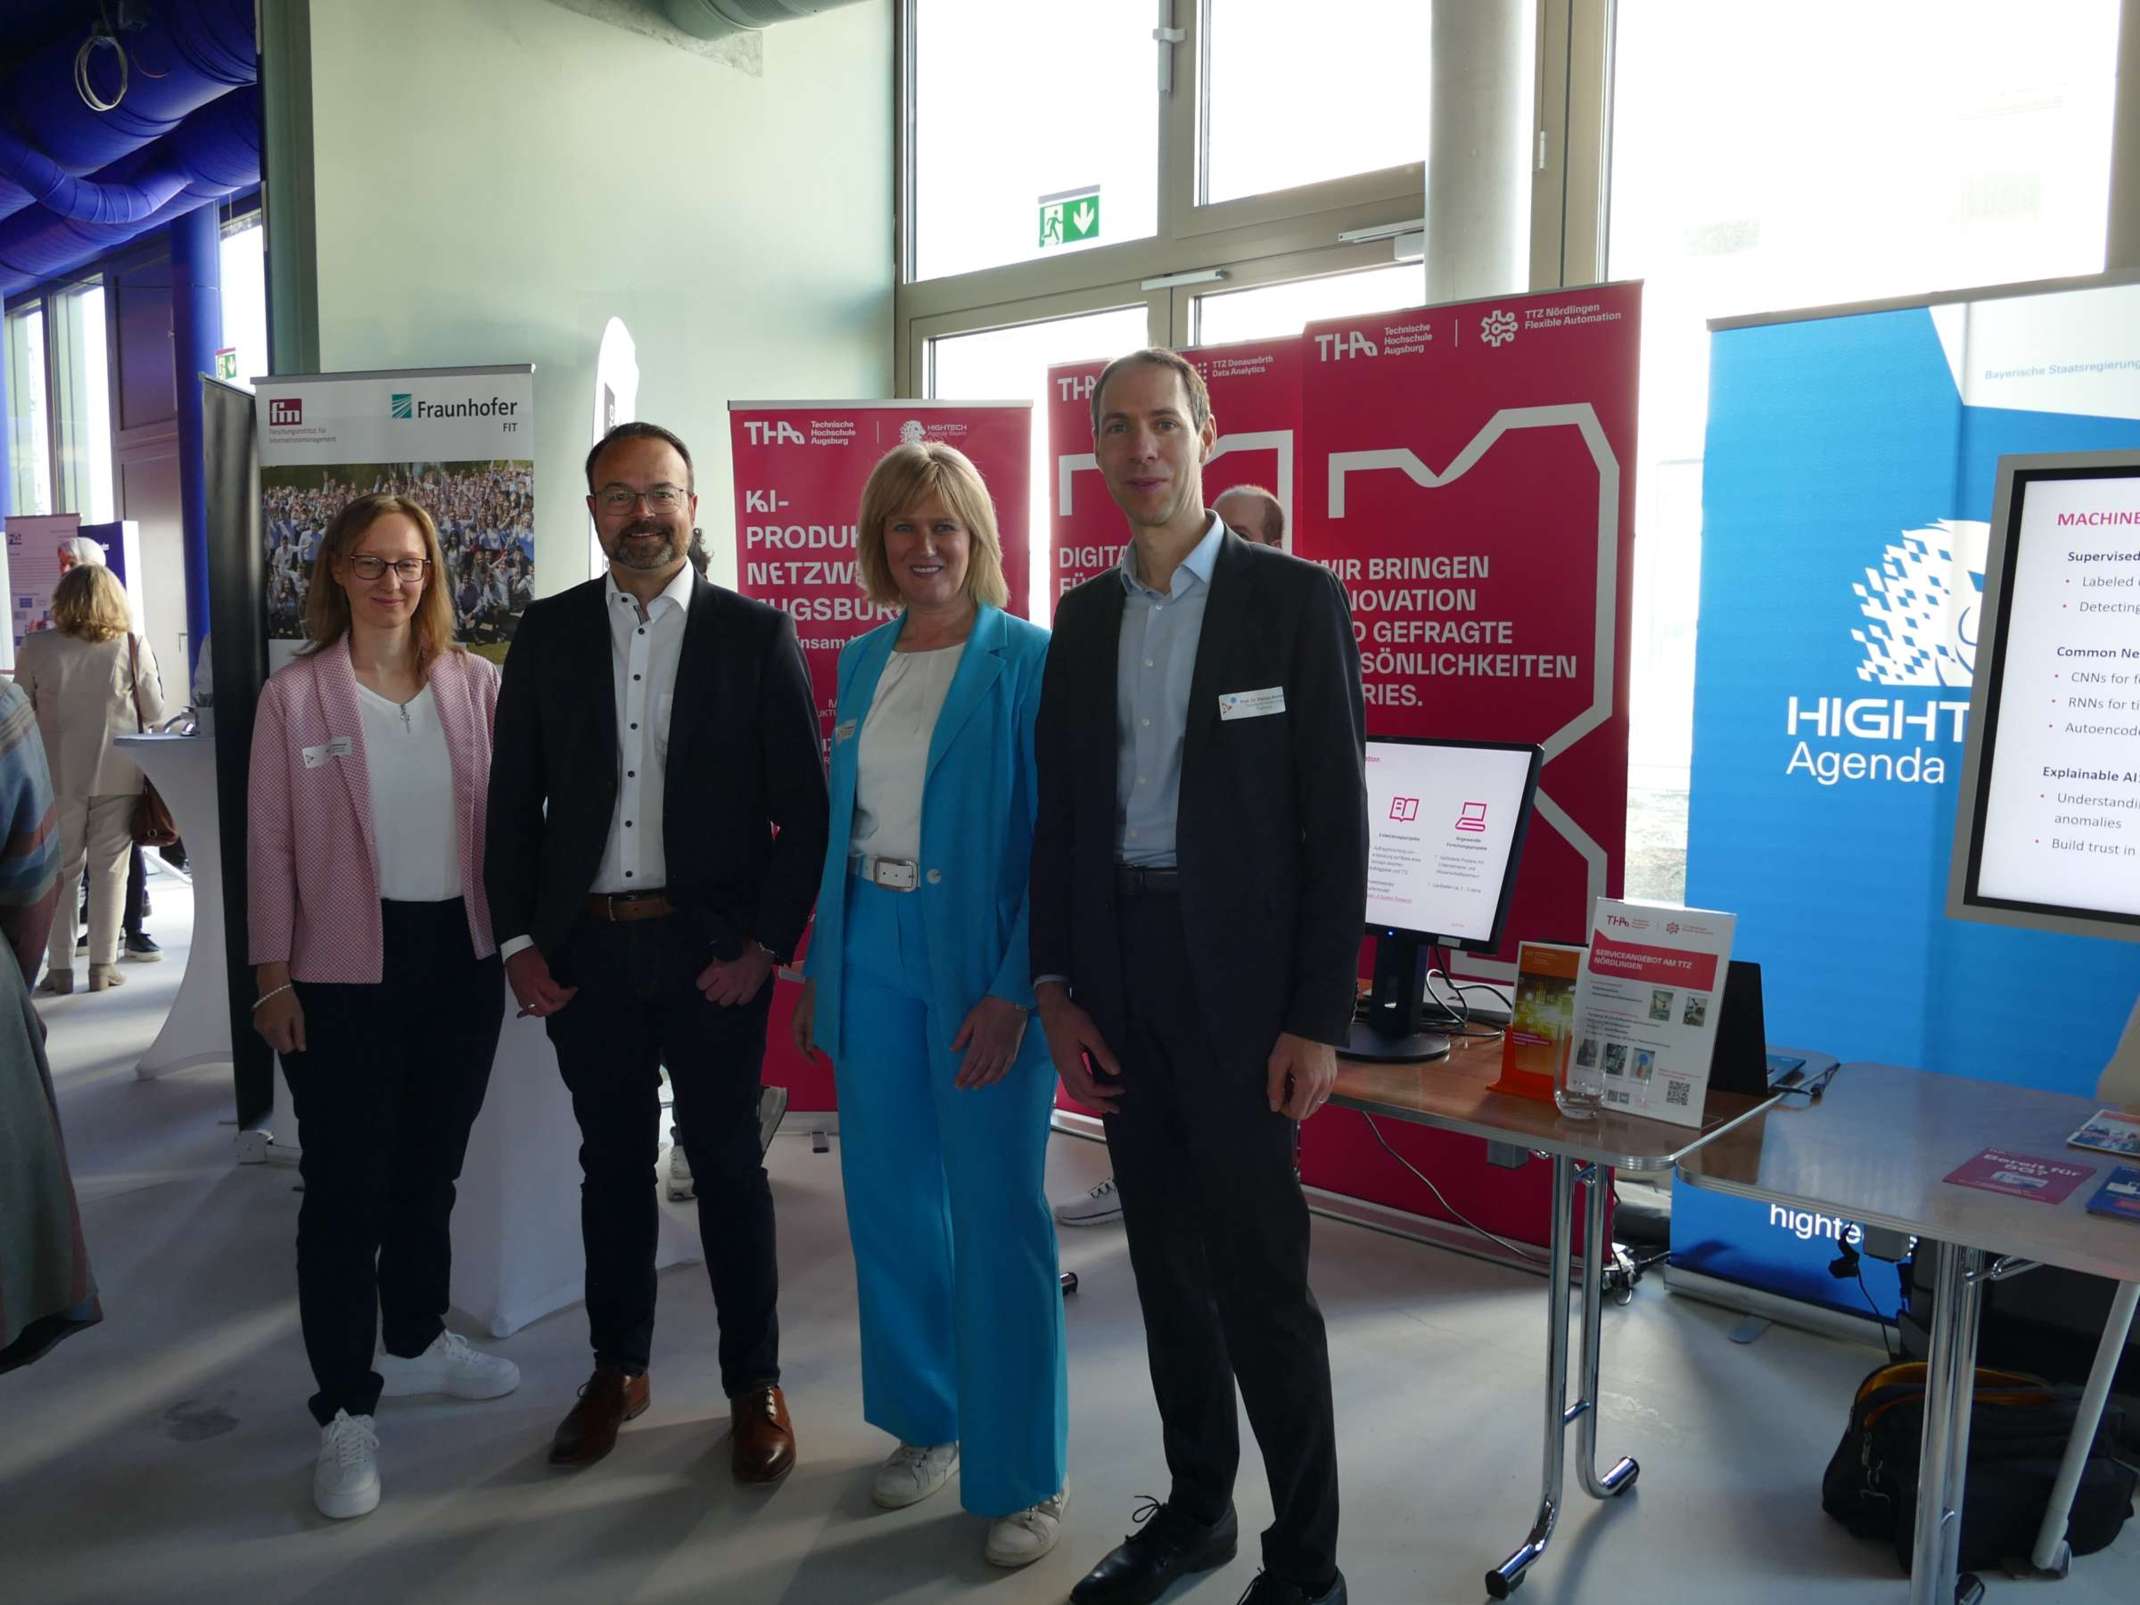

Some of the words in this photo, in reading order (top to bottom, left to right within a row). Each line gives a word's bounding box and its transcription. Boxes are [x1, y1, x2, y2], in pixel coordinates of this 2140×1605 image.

[1525, 309, 1544, 319] TTZ
[1546, 303, 1600, 318] Nördlingen
[1525, 318, 1562, 329] Flexible
[1563, 311, 1621, 326] Automation
[1384, 323, 1431, 336] Technische
[1384, 333, 1433, 345] Hochschule
[1384, 343, 1425, 355] Augsburg
[1212, 368, 1230, 377] Data
[1230, 366, 1266, 377] Analytics
[418, 397, 518, 418] Fraunhofer
[503, 422, 518, 432] FIT
[811, 420, 854, 429] Technische
[811, 429, 856, 437] Hochschule
[811, 437, 849, 446] Augsburg
[746, 490, 789, 513] KI-
[2057, 511, 2140, 526] MACHINE
[1060, 545, 1128, 568] DIGITA
[2067, 551, 2140, 563] Supervised
[748, 561, 858, 585] NETZW
[1368, 556, 1489, 580] BRINGEN
[2082, 576, 2134, 587] Labeled
[1373, 621, 1513, 644] GEFRAGTE
[2057, 646, 2116, 658] Common
[1361, 647, 1577, 678] SÖNLICHKEITEN
[2071, 672, 2106, 683] CNNs
[2111, 672, 2129, 684] for
[2068, 697, 2104, 709] RNNs
[2108, 698, 2127, 710] for
[1787, 696, 1970, 742] HIGHT
[1786, 741, 1945, 785] Agenda
[2043, 766, 2119, 781] Explainable
[2057, 792, 2140, 809] Understandi
[2054, 815, 2122, 829] anomalies
[2052, 838, 2085, 851] Build
[2089, 842, 2119, 855] trust
[2124, 844, 2136, 856] in
[1770, 1203, 1862, 1244] highte
